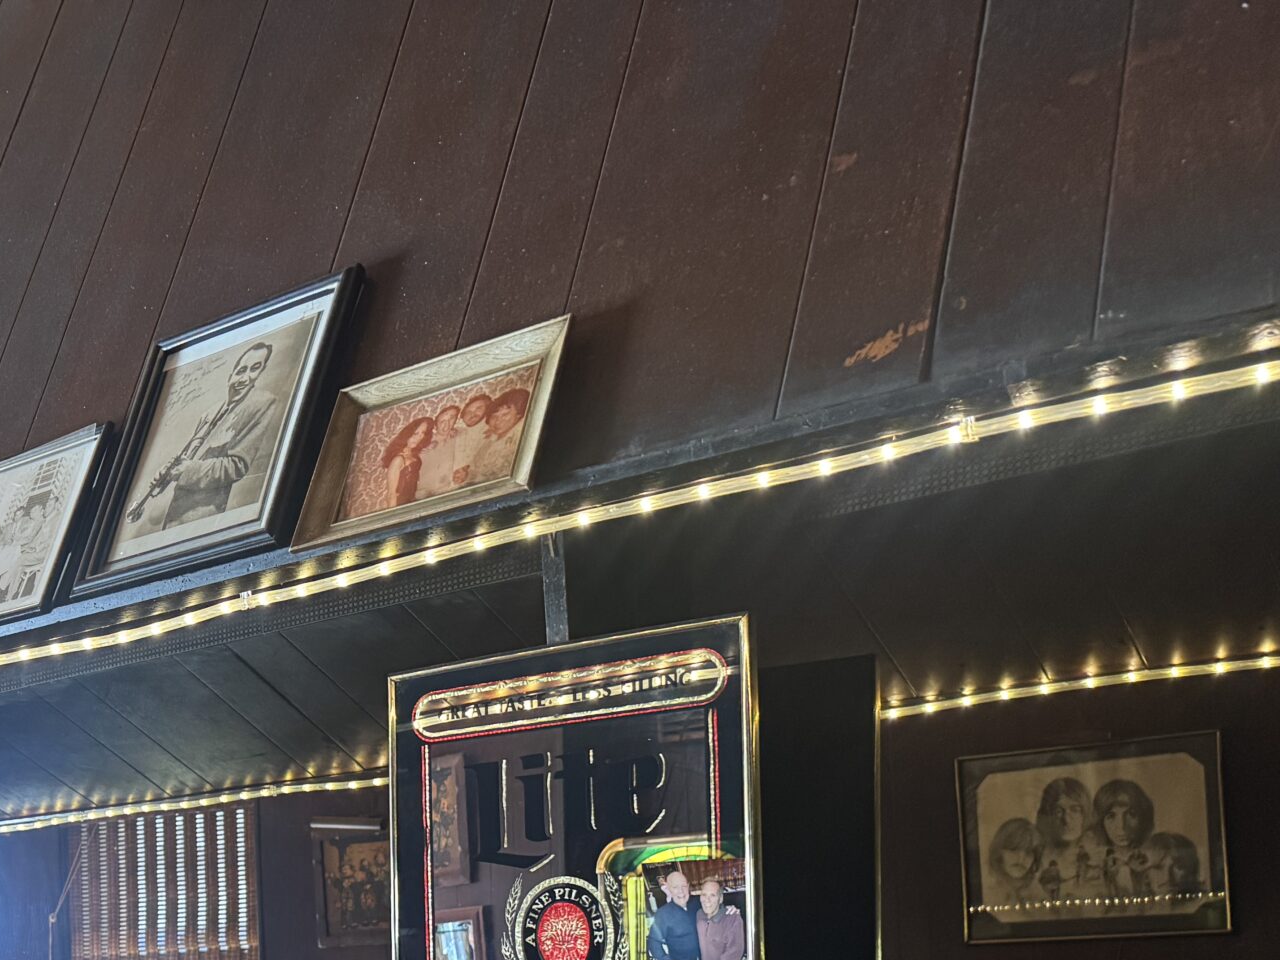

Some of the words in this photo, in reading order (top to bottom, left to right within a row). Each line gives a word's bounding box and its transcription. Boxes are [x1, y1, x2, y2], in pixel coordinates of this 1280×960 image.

[465, 748, 666, 872] Lite
[525, 891, 550, 932] FINE
[554, 887, 604, 946] PILSNER
[524, 935, 536, 947] A
